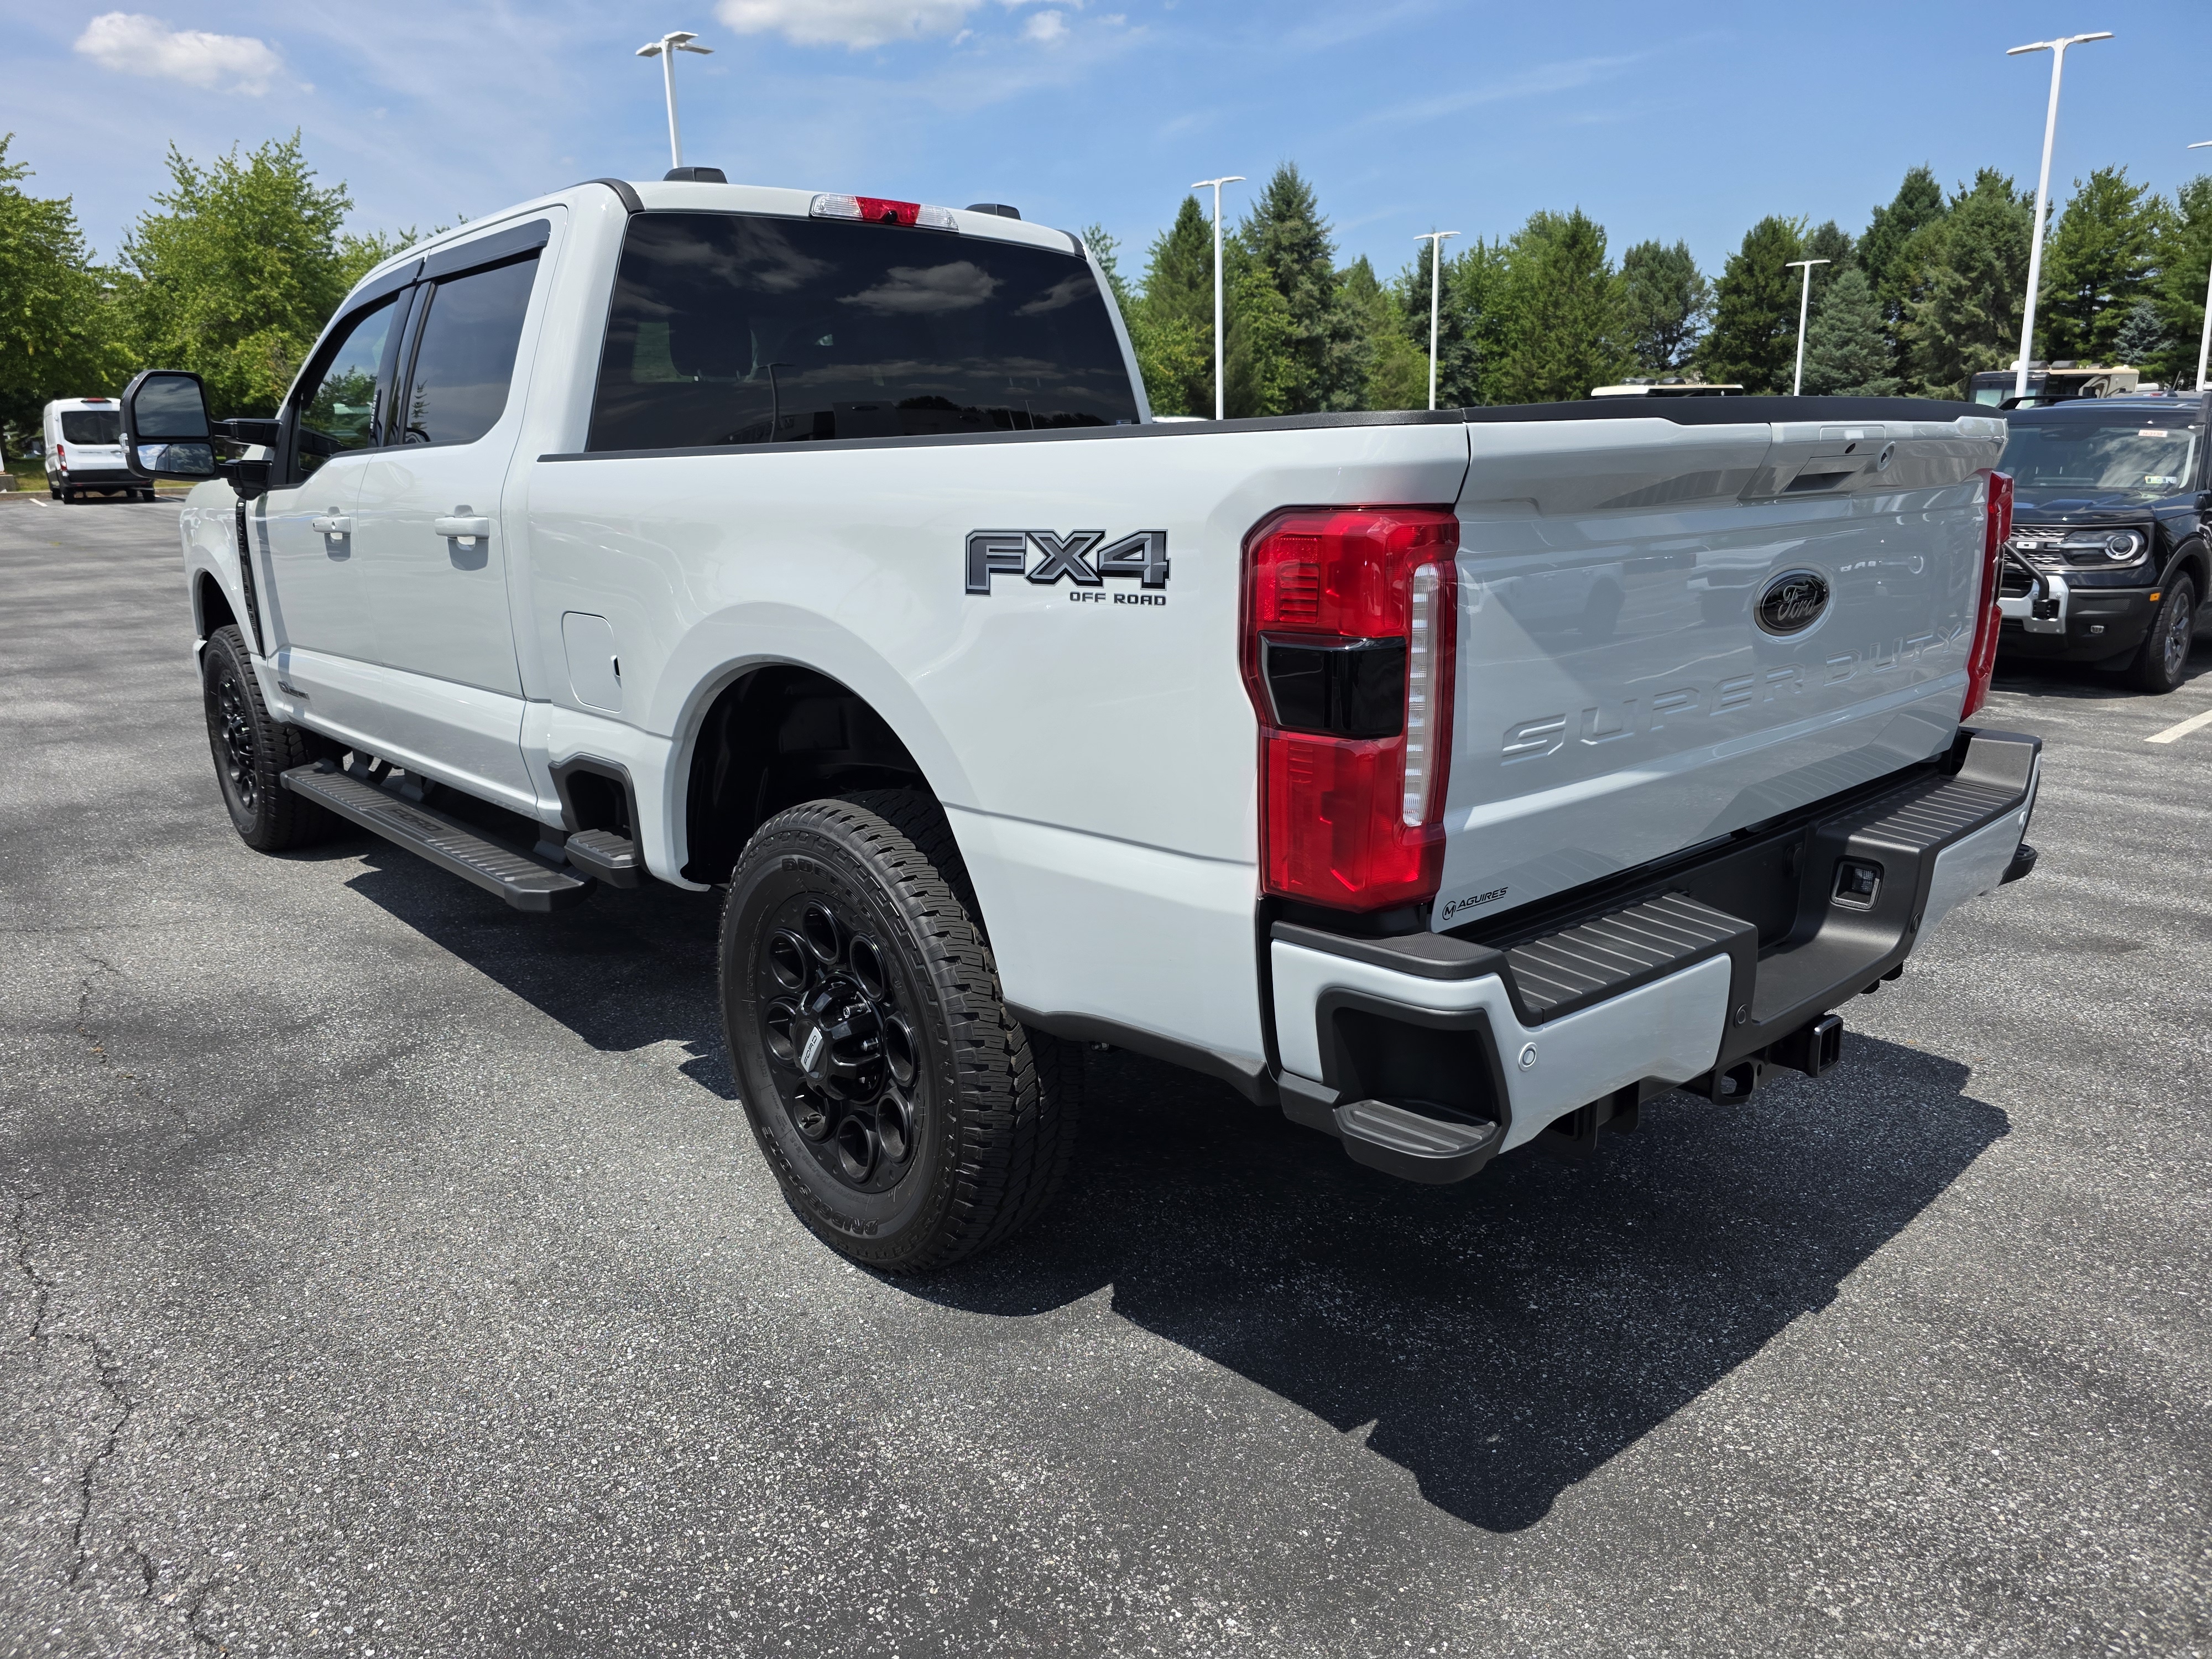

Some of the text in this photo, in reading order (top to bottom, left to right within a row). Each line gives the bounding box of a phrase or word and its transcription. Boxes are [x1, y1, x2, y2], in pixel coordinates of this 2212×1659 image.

[965, 529, 1171, 597] FX4
[1070, 591, 1167, 607] OFF ROAD
[1777, 584, 1818, 621] Ford
[1500, 620, 1965, 767] SUPER DUTY
[388, 808, 445, 831] FORD
[781, 857, 877, 927] DUELER
[804, 1035, 817, 1066] FORD
[761, 1125, 879, 1236] BRIDGESTONE
